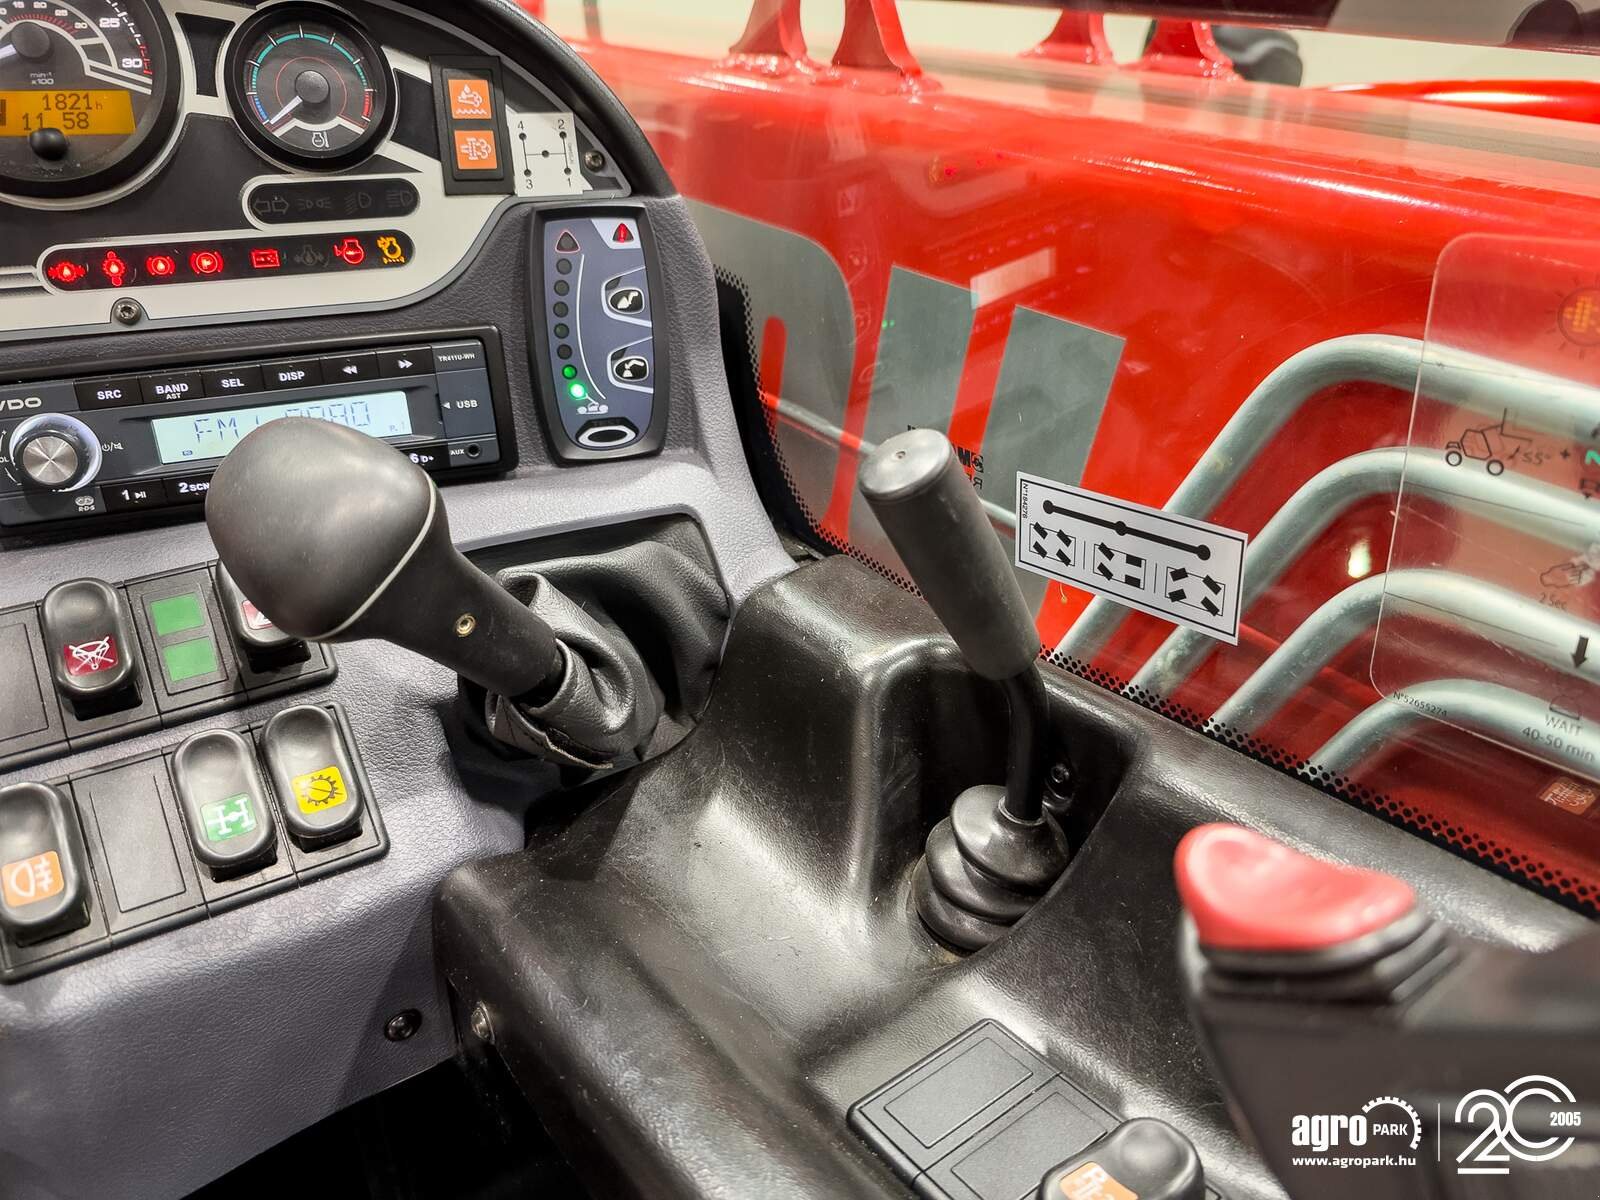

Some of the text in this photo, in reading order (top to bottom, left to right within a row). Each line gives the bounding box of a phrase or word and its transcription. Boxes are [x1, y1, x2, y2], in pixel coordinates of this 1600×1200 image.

[99, 18, 121, 28] 25
[122, 58, 143, 68] 30
[42, 93, 93, 111] 1821
[62, 112, 89, 130] 58
[517, 119, 566, 130] 4 2
[526, 178, 572, 189] 3 1
[278, 370, 306, 382] DISP
[221, 378, 245, 388] SEL
[97, 389, 122, 400] SRC
[155, 383, 189, 395] BAND
[166, 392, 182, 400] AST
[456, 399, 478, 410] USB
[450, 448, 465, 457] AUX
[409, 453, 420, 464] 6
[178, 482, 189, 494] 2
[121, 489, 130, 501] 1
[1545, 713, 1583, 736] WAIT
[1522, 726, 1596, 761] 40-50 min
